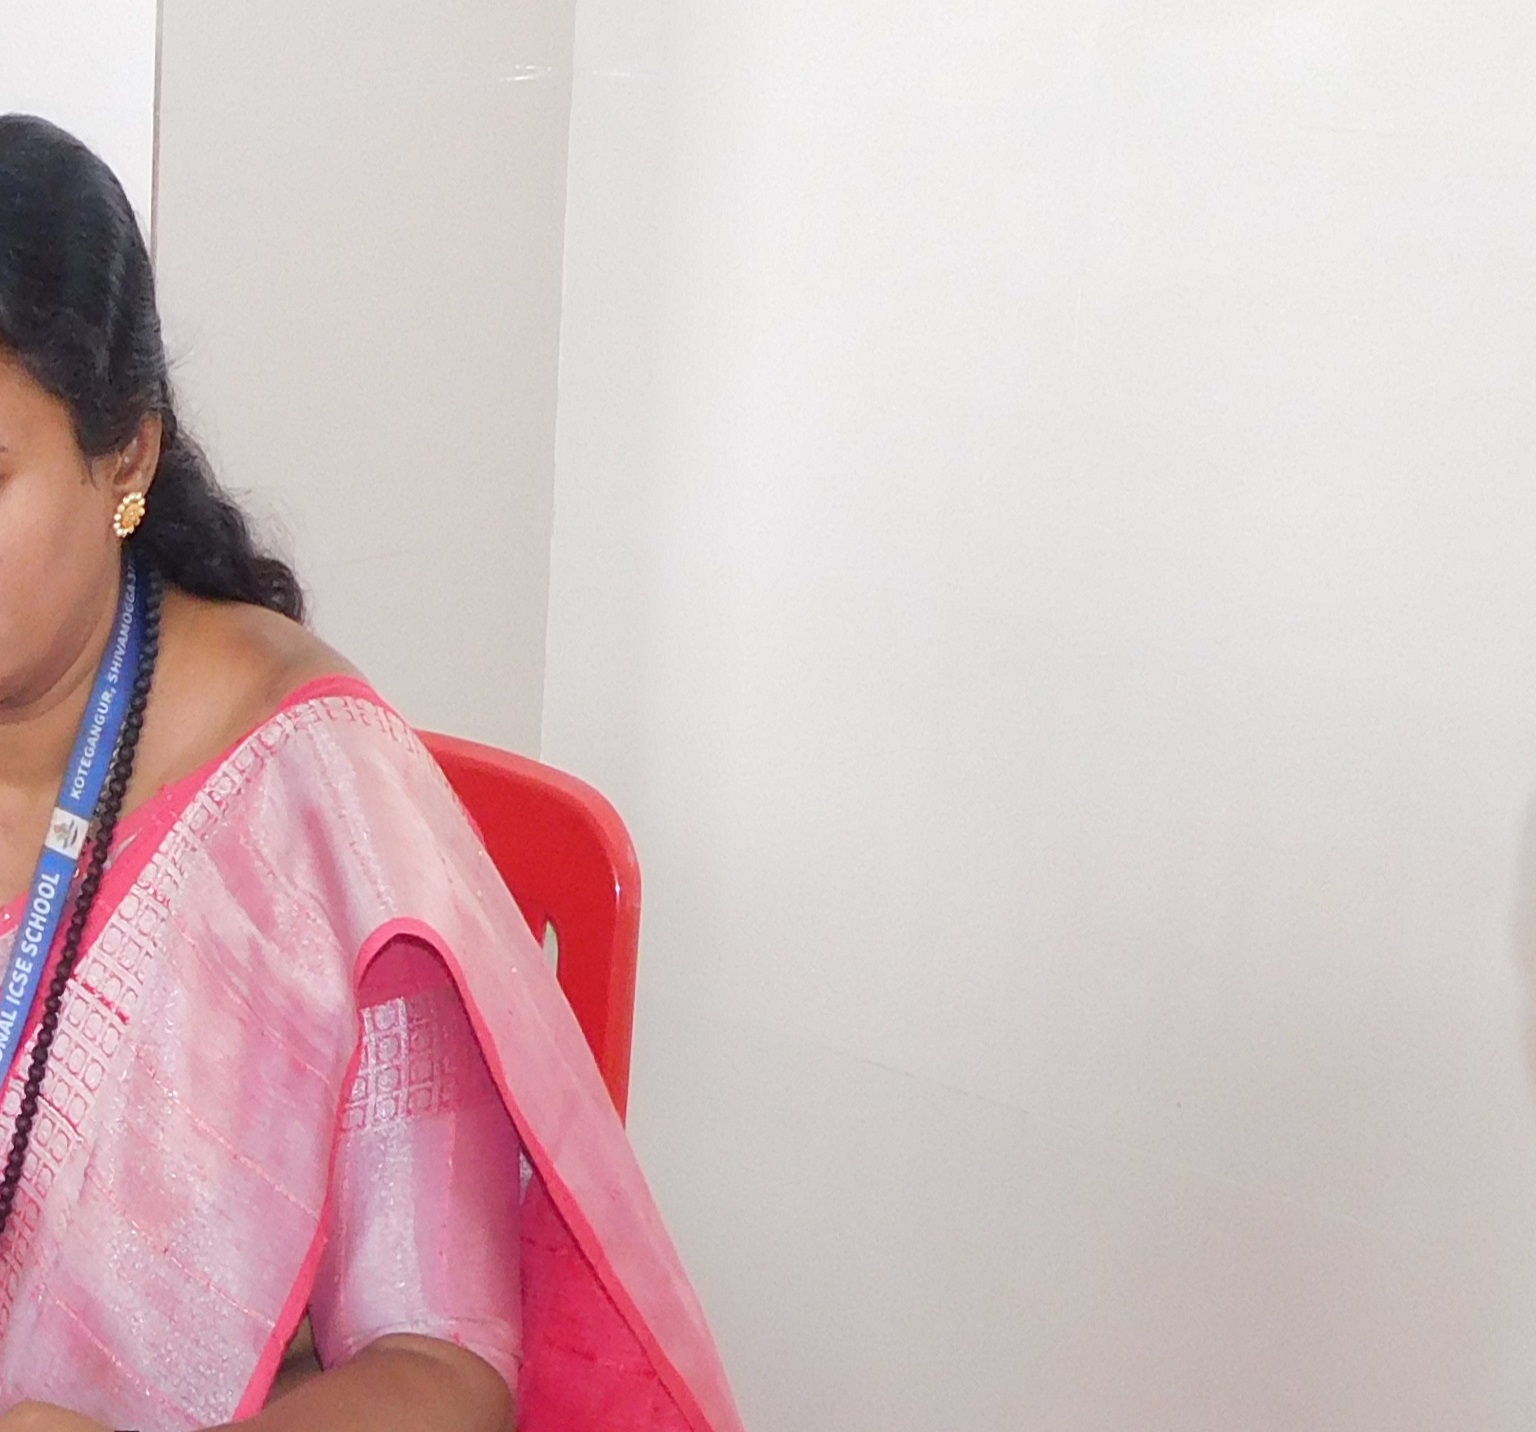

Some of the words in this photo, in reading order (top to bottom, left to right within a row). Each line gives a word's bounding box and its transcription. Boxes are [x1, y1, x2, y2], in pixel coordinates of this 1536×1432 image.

[70, 686, 118, 800] KOTEGANGUR,
[5, 958, 33, 1005] ICSE
[20, 872, 60, 957] SCHOOL
